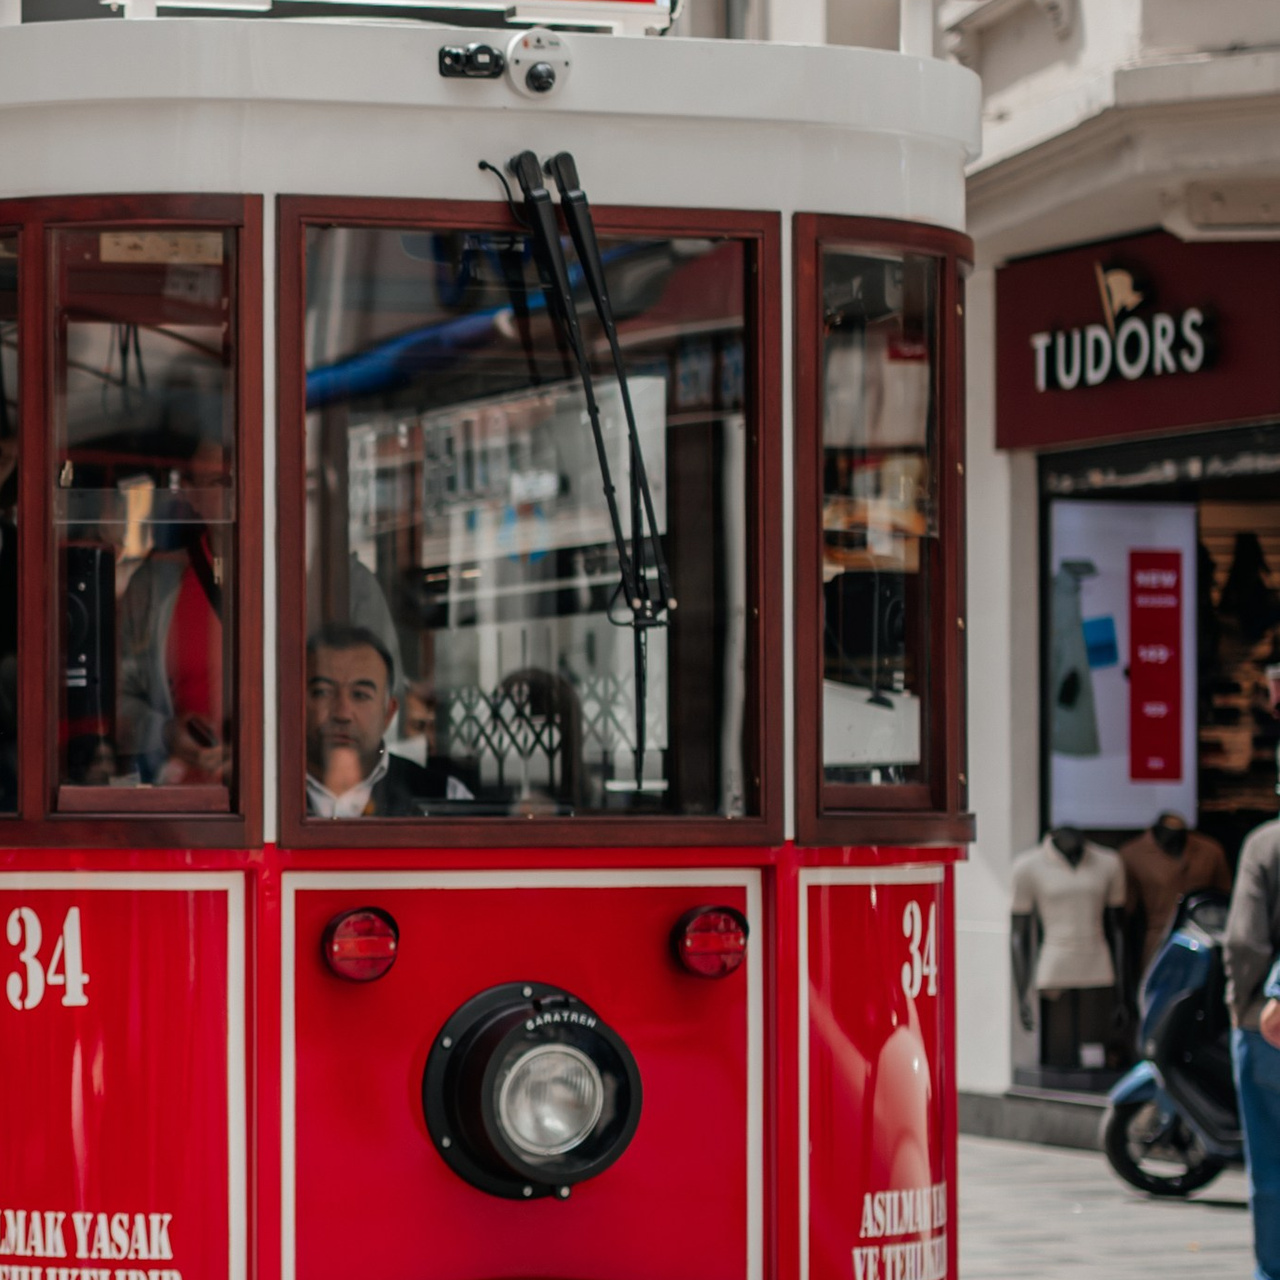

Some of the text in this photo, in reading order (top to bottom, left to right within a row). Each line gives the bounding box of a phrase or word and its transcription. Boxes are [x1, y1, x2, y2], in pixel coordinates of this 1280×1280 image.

[1031, 307, 1205, 393] TUDORS
[6, 906, 90, 1010] 34
[902, 900, 937, 999] 34
[71, 1212, 173, 1261] YASAK
